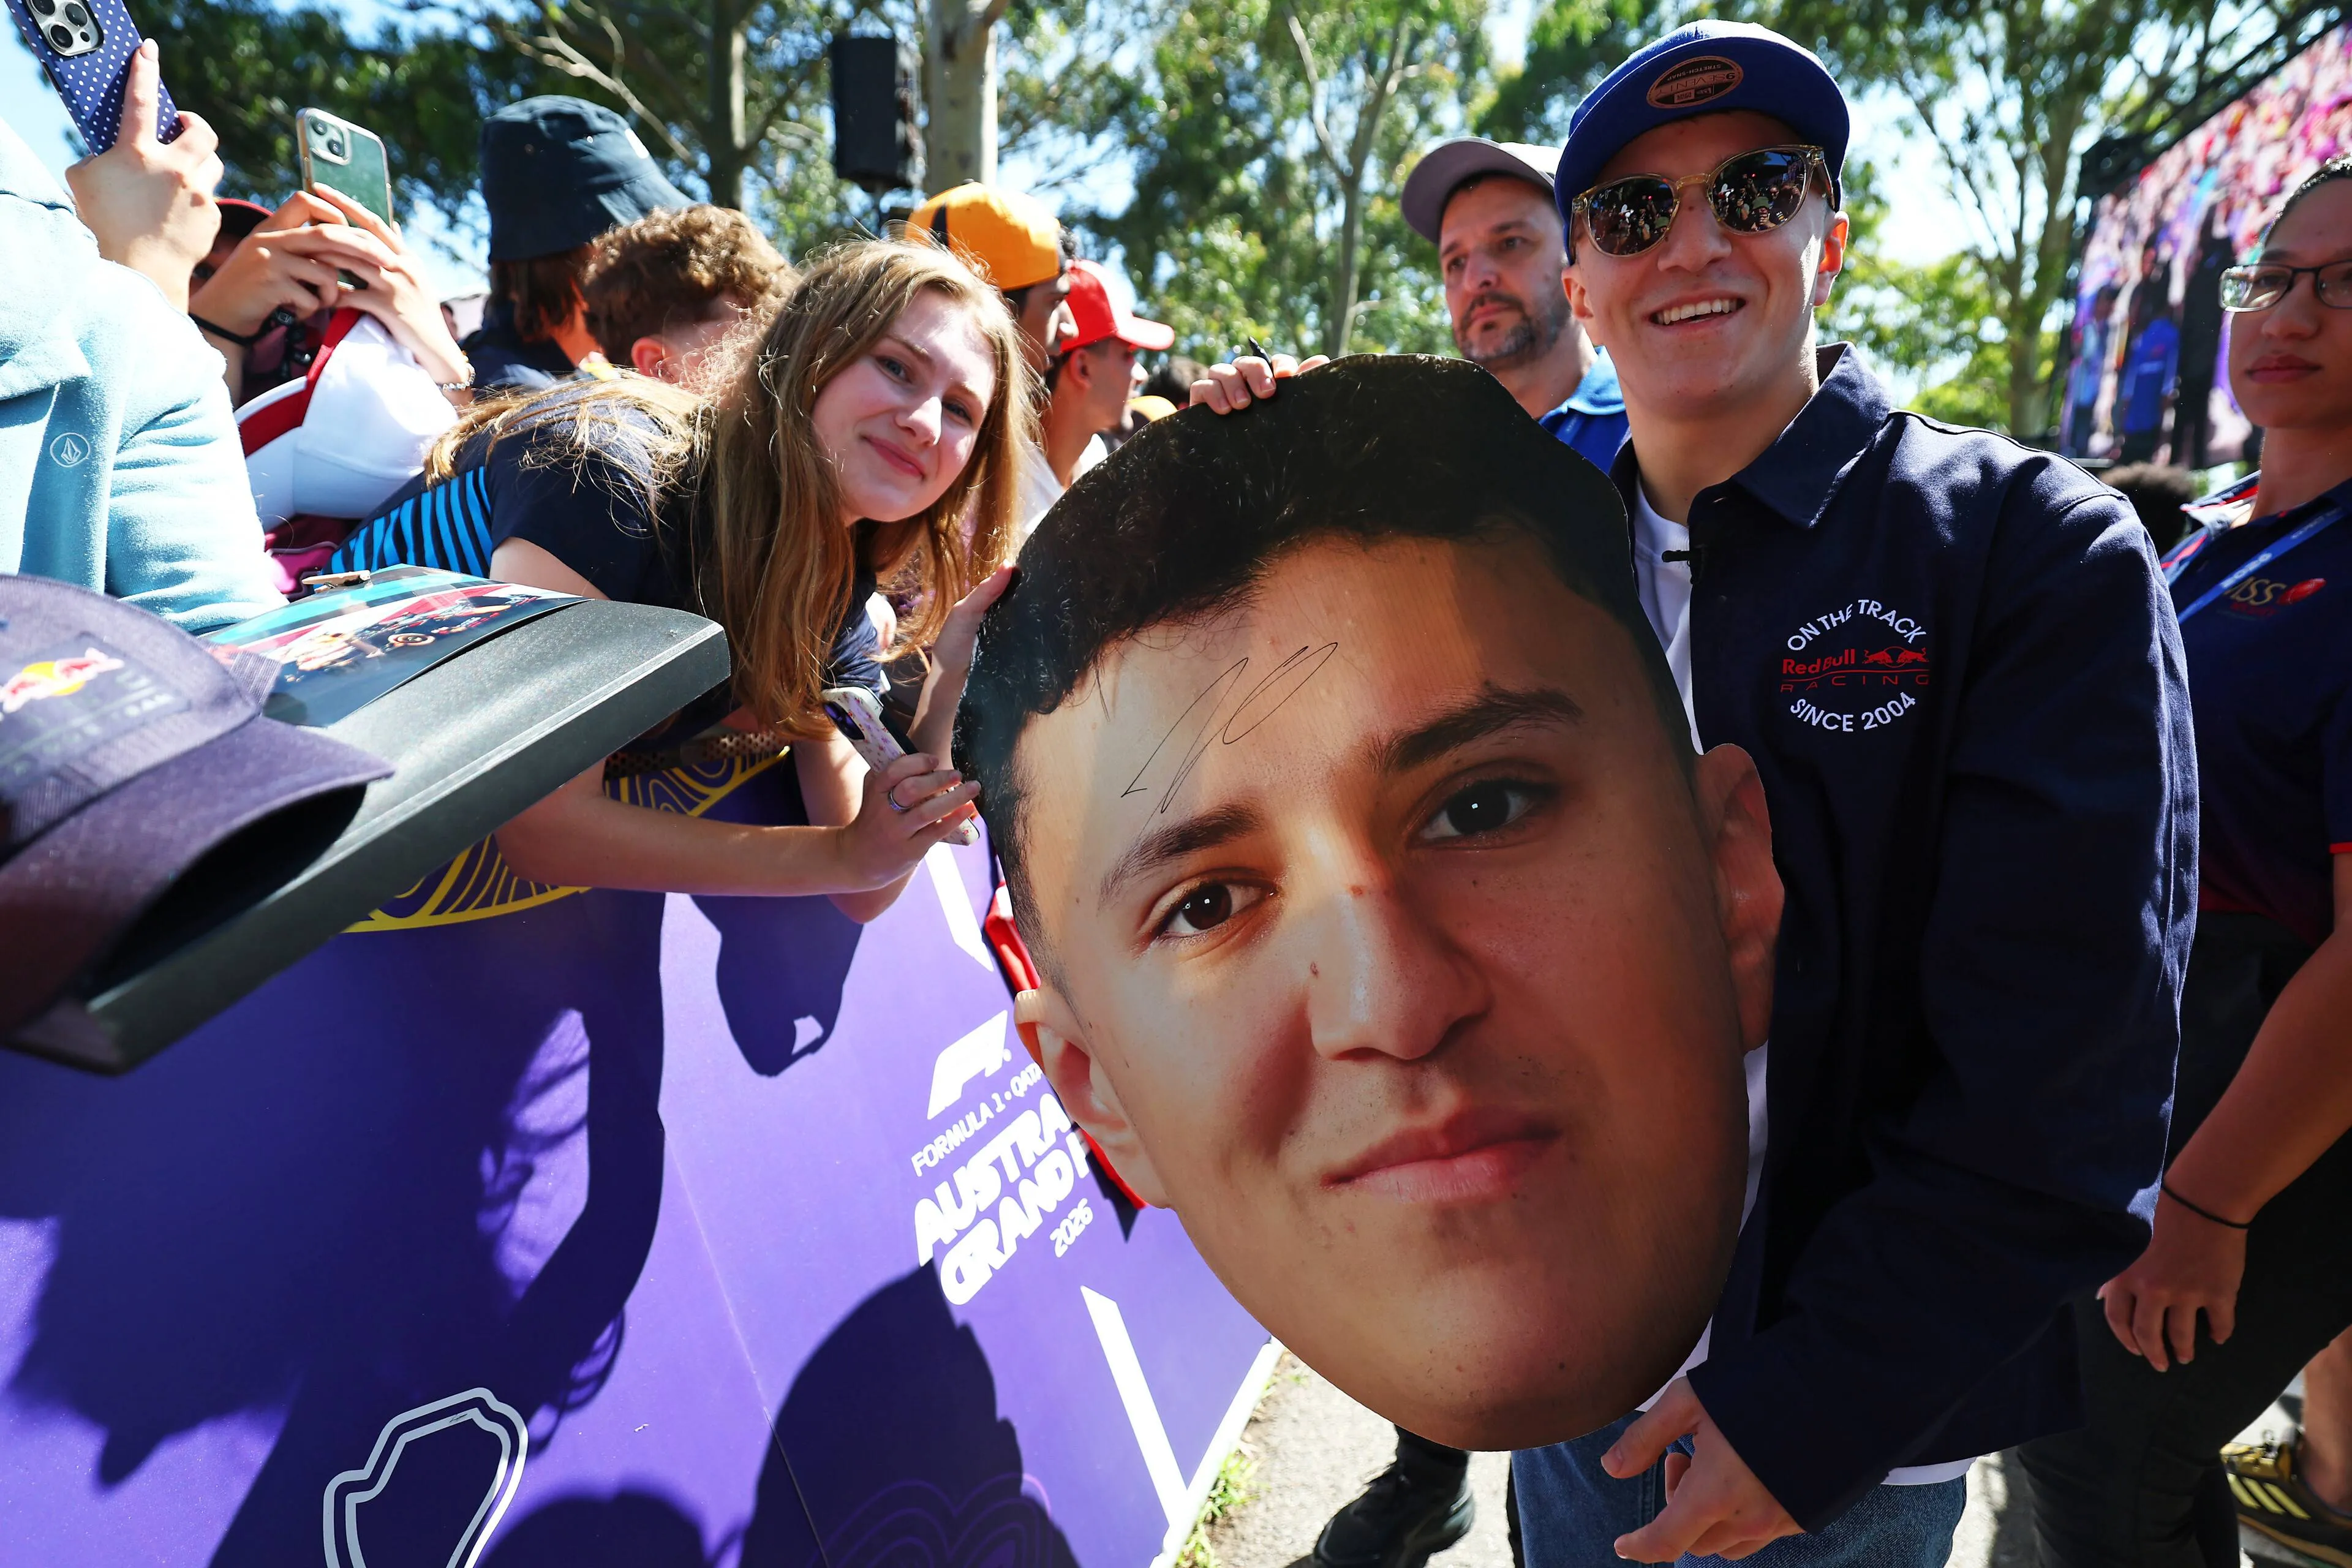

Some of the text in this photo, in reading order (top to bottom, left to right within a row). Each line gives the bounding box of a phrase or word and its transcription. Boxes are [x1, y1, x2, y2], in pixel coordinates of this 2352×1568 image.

[1787, 600, 1926, 650] ON THE TRACK
[1781, 675, 1929, 692] RACING
[1790, 692, 1915, 731] SINCE 2004
[911, 1103, 993, 1177] FORMULA
[1050, 1198, 1093, 1257] 2026
